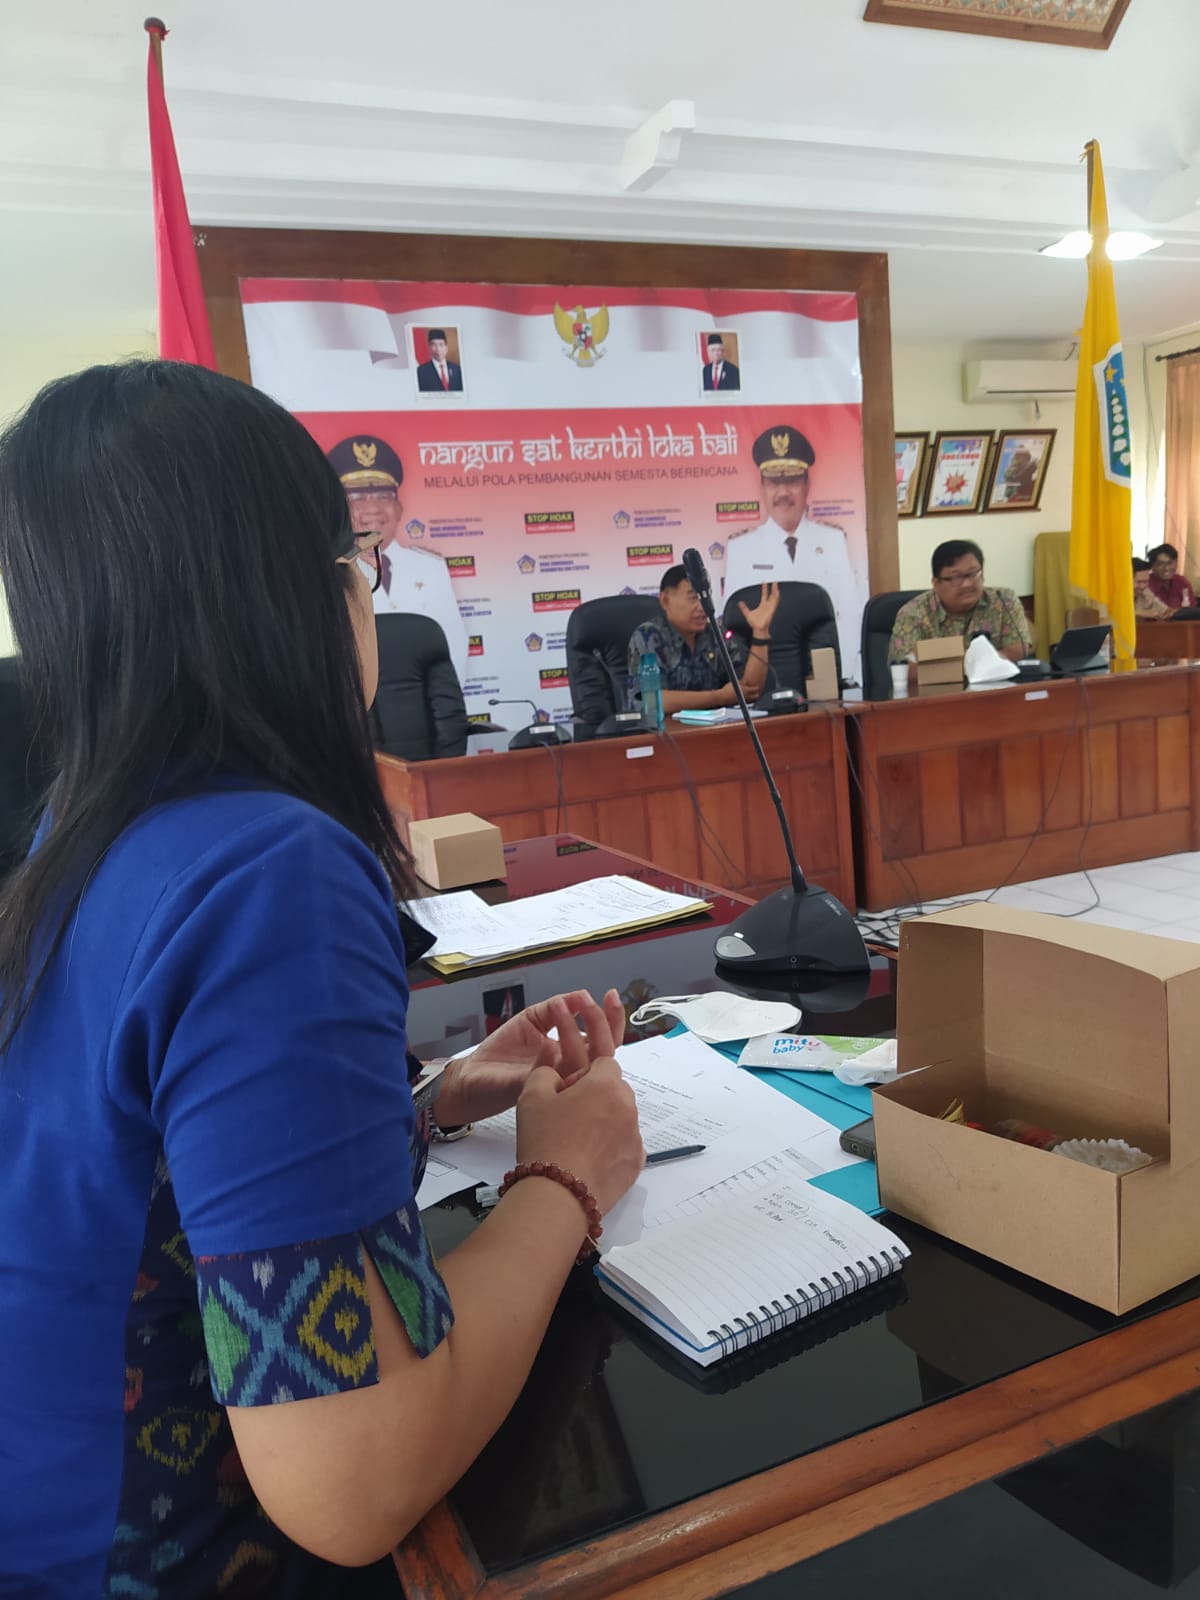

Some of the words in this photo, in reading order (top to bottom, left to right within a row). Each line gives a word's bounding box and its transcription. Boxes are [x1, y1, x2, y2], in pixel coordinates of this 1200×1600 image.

[418, 440, 514, 473] nangun
[520, 434, 562, 467] sat
[566, 425, 642, 461] kerthi
[646, 423, 694, 458] loka
[697, 421, 738, 456] bali
[424, 475, 479, 489] MELALUI
[482, 474, 517, 487] POLA
[519, 471, 611, 486] PEMBANGUNAN
[614, 468, 667, 482] SEMESTA
[670, 466, 738, 479] BERENCANA
[718, 502, 737, 512] STOP
[738, 501, 758, 511] HOAX
[527, 513, 548, 523] STOP
[549, 512, 573, 522] HOAX
[629, 546, 648, 556] STOP
[650, 545, 671, 555] HOAX
[448, 556, 472, 566] HOAX
[534, 592, 555, 602] STOP
[556, 591, 578, 601] HOAX
[542, 669, 563, 679] STOP
[773, 1044, 805, 1054] baby
